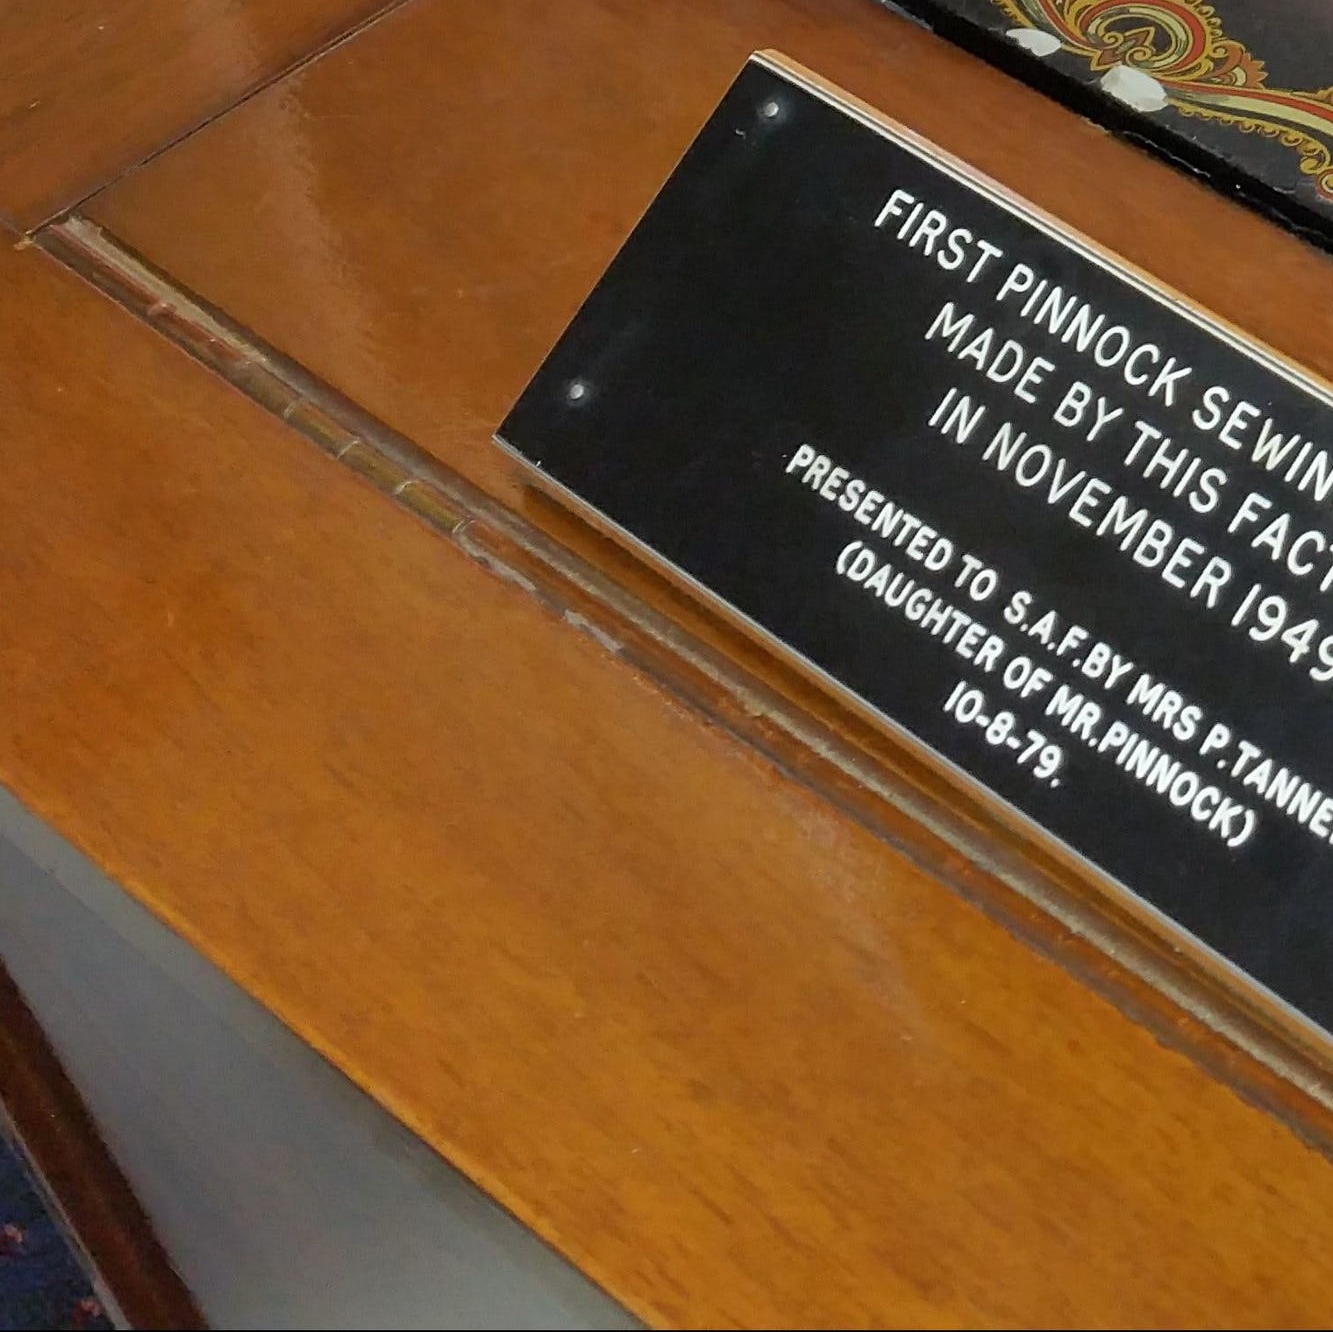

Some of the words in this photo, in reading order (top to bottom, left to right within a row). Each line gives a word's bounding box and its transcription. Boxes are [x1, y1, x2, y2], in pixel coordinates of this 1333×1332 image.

[873, 188, 1005, 284] FIRST
[994, 262, 1194, 409] PINNOCK
[923, 300, 1057, 405] MADE
[1051, 379, 1126, 443] BY
[1122, 419, 1230, 515] THIS
[784, 442, 956, 573] PRESENTED
[953, 552, 1000, 603] TO
[1124, 672, 1205, 743] MRS
[927, 386, 987, 445] IN
[981, 420, 1234, 610] NOVEMBER
[835, 539, 1007, 674] (DAUGHTER
[1001, 654, 1055, 700] OF
[941, 679, 1065, 789] 10-8-79.
